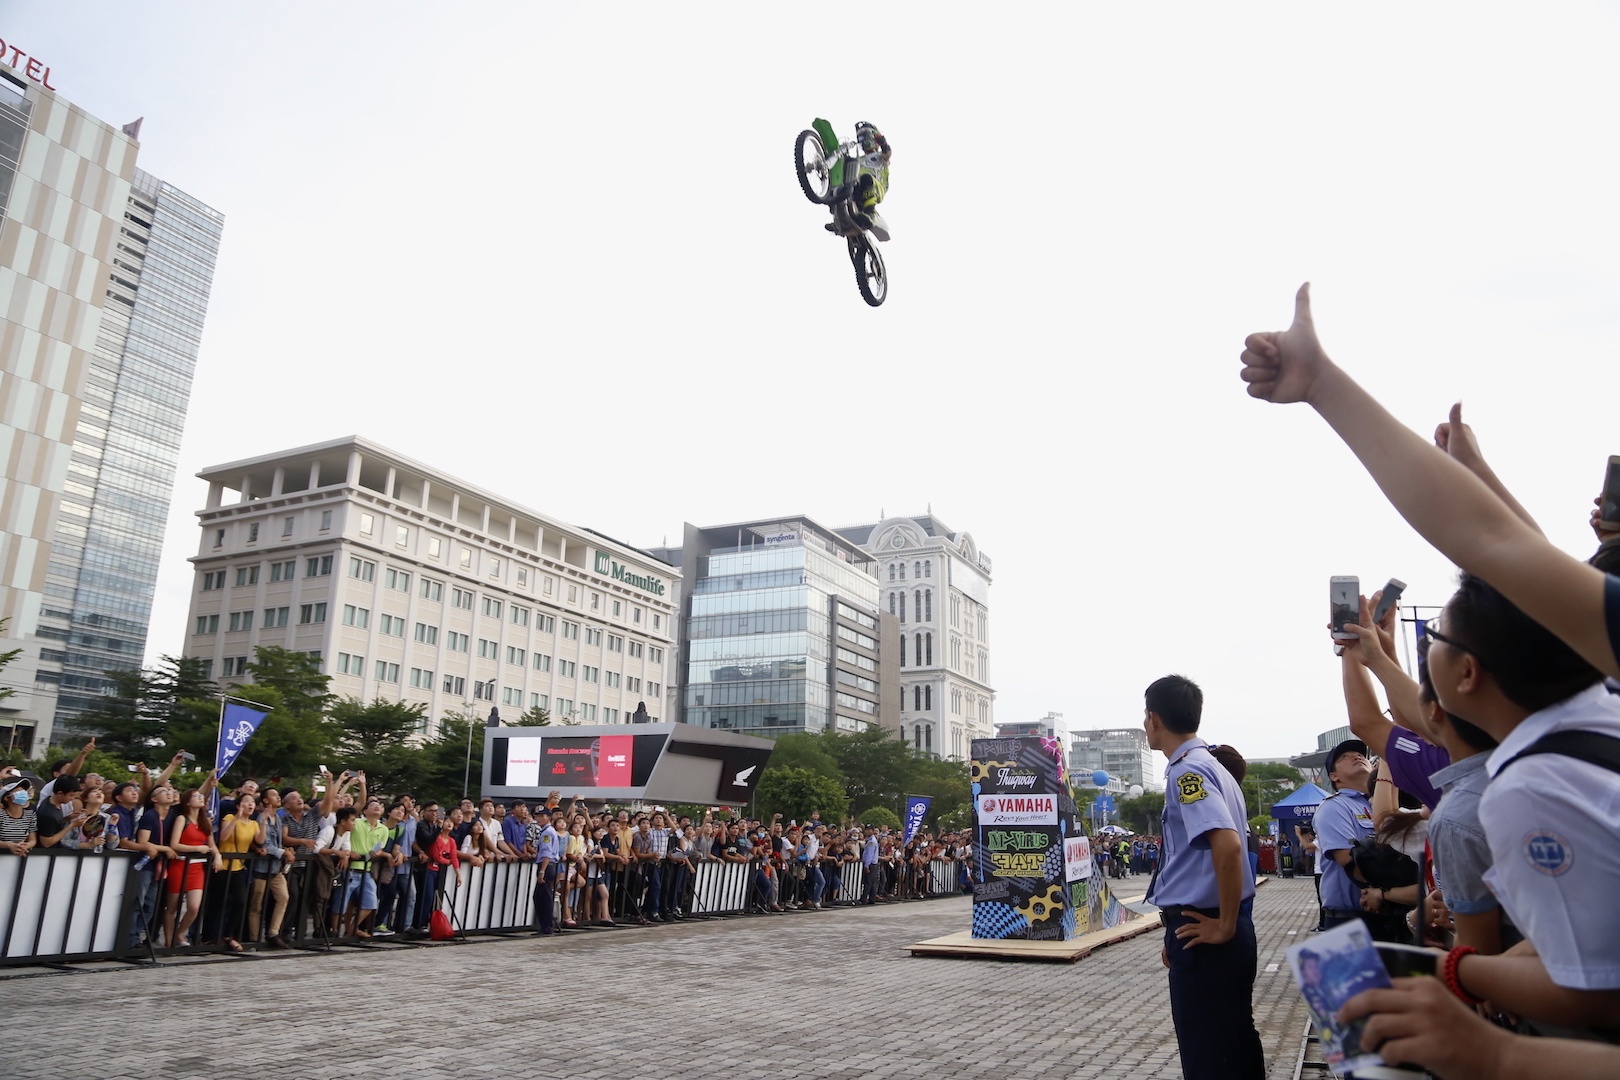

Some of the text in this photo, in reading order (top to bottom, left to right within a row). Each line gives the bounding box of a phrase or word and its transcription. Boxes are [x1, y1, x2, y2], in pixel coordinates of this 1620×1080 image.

[766, 533, 795, 543] syngenta
[611, 561, 665, 596] Manulife
[996, 768, 1037, 789] Thugway
[1185, 784, 1196, 794] 24
[998, 798, 1053, 812] YAMAHA
[993, 814, 1014, 823] Revs
[1072, 842, 1090, 862] YAMAHA
